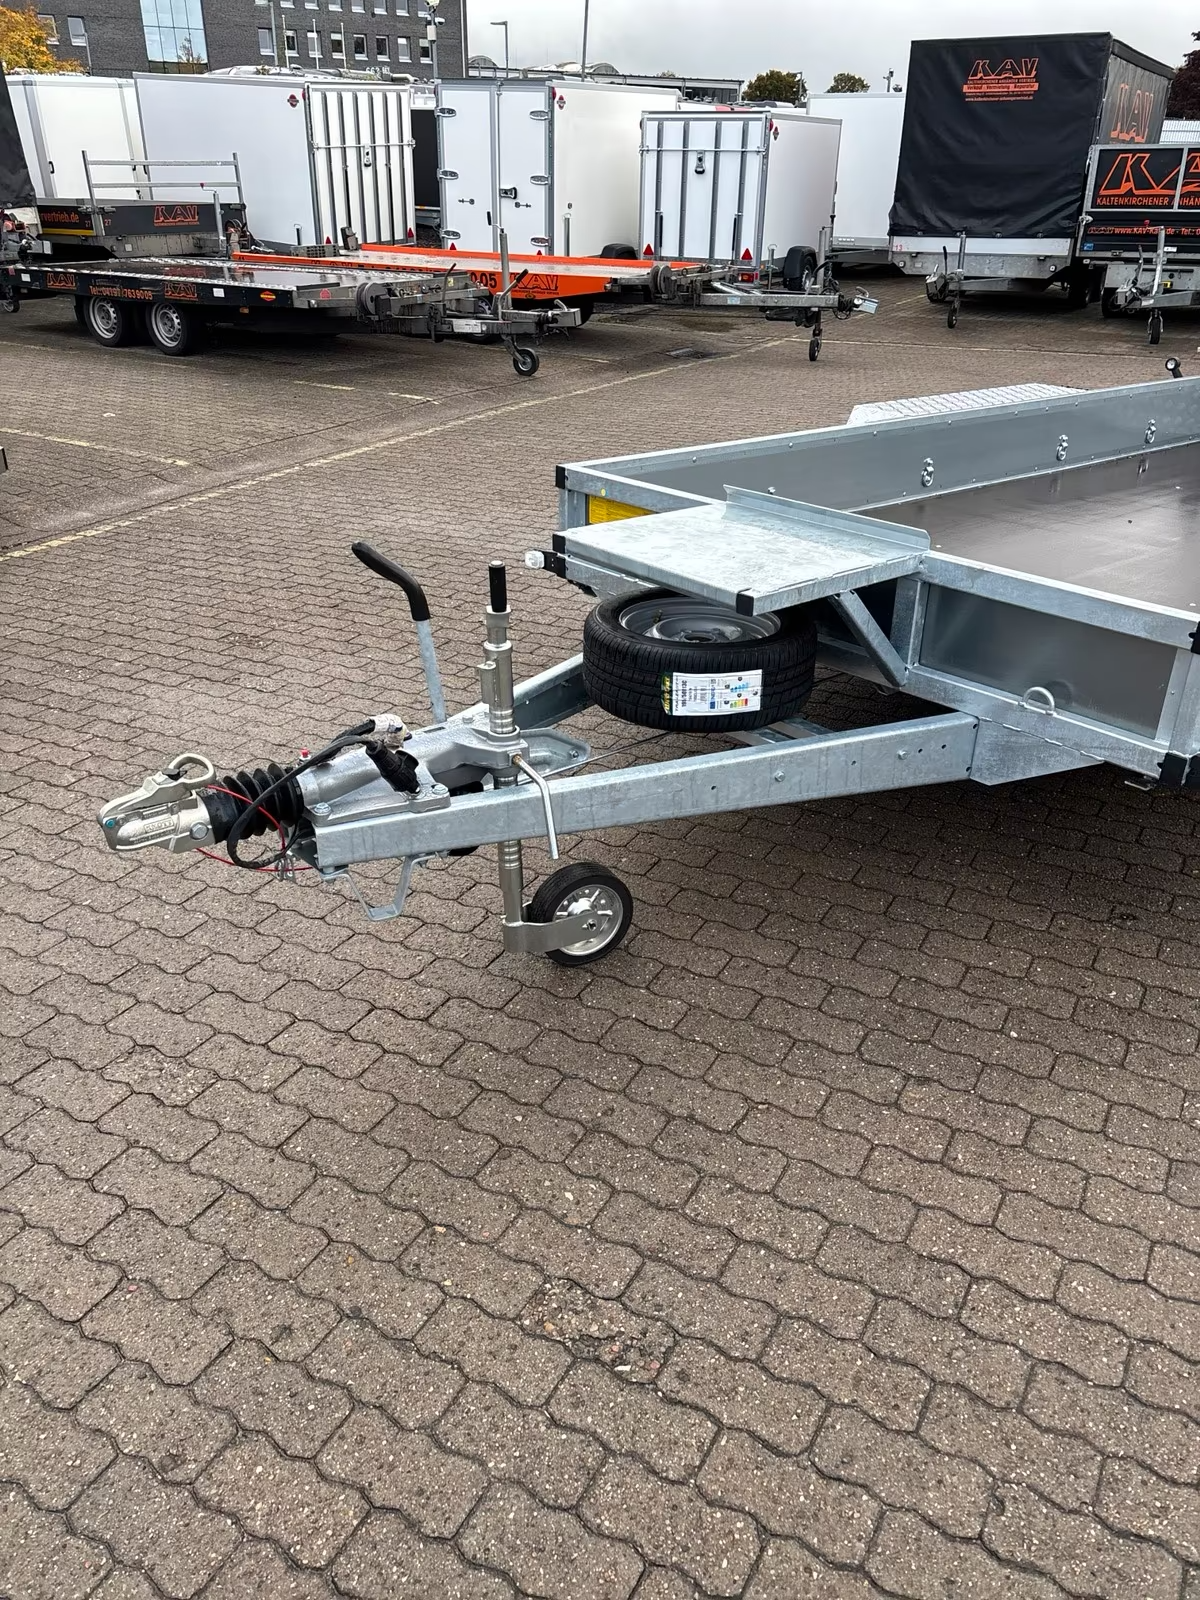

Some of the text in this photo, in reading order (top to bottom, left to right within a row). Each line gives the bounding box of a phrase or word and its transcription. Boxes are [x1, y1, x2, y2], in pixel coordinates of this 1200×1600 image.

[968, 58, 1039, 79] KAV
[1110, 83, 1153, 143] KAV
[1096, 197, 1169, 206] KALTENKIRCHENER
[154, 205, 199, 222] KAV
